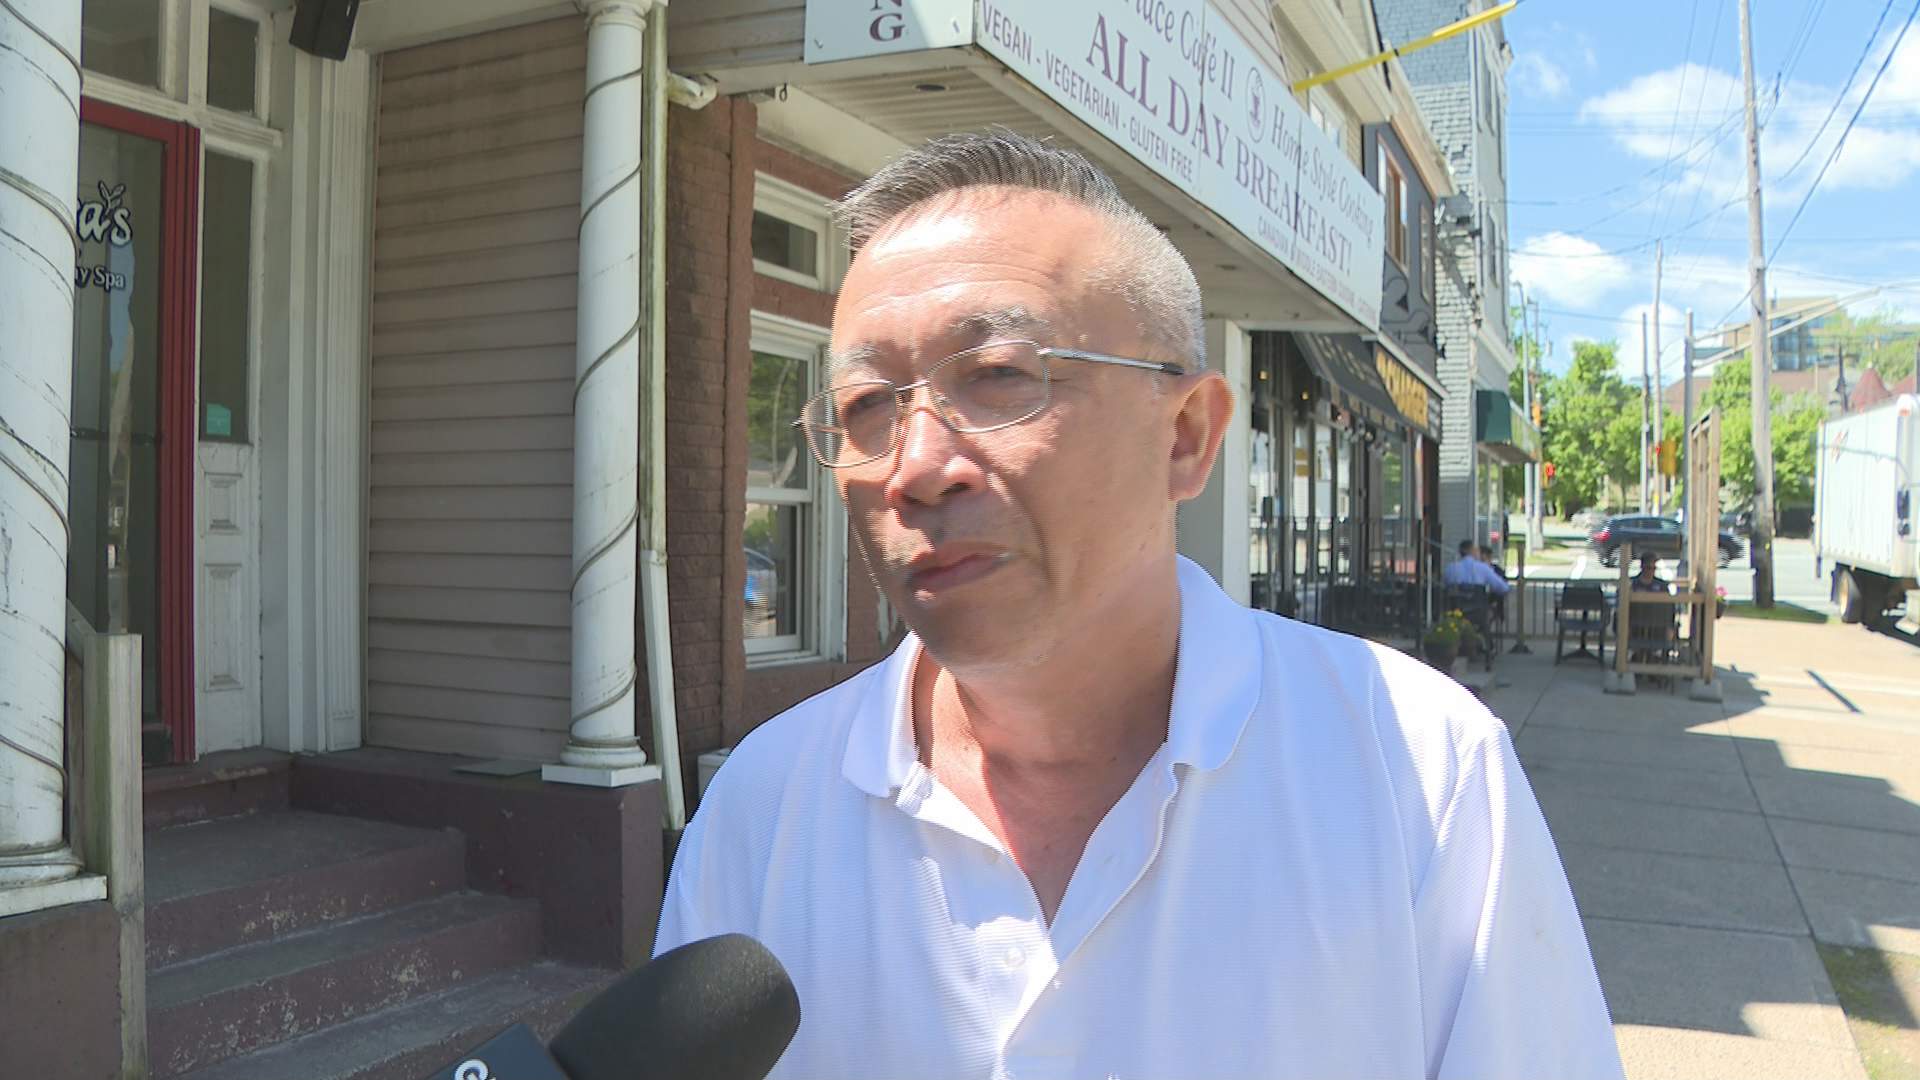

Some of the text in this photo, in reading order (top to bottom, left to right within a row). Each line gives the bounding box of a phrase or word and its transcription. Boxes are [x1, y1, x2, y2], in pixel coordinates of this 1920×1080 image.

[982, 0, 1032, 66] VEGAN
[1045, 47, 1120, 131] VEGETARIAN
[1129, 115, 1169, 166] GLUTEN
[1171, 146, 1193, 183] FREE
[1085, 11, 1352, 277] ALL DAY BREAKFAST!
[1271, 103, 1309, 176] Home
[1310, 146, 1338, 202] Style
[94, 265, 126, 293] Spa
